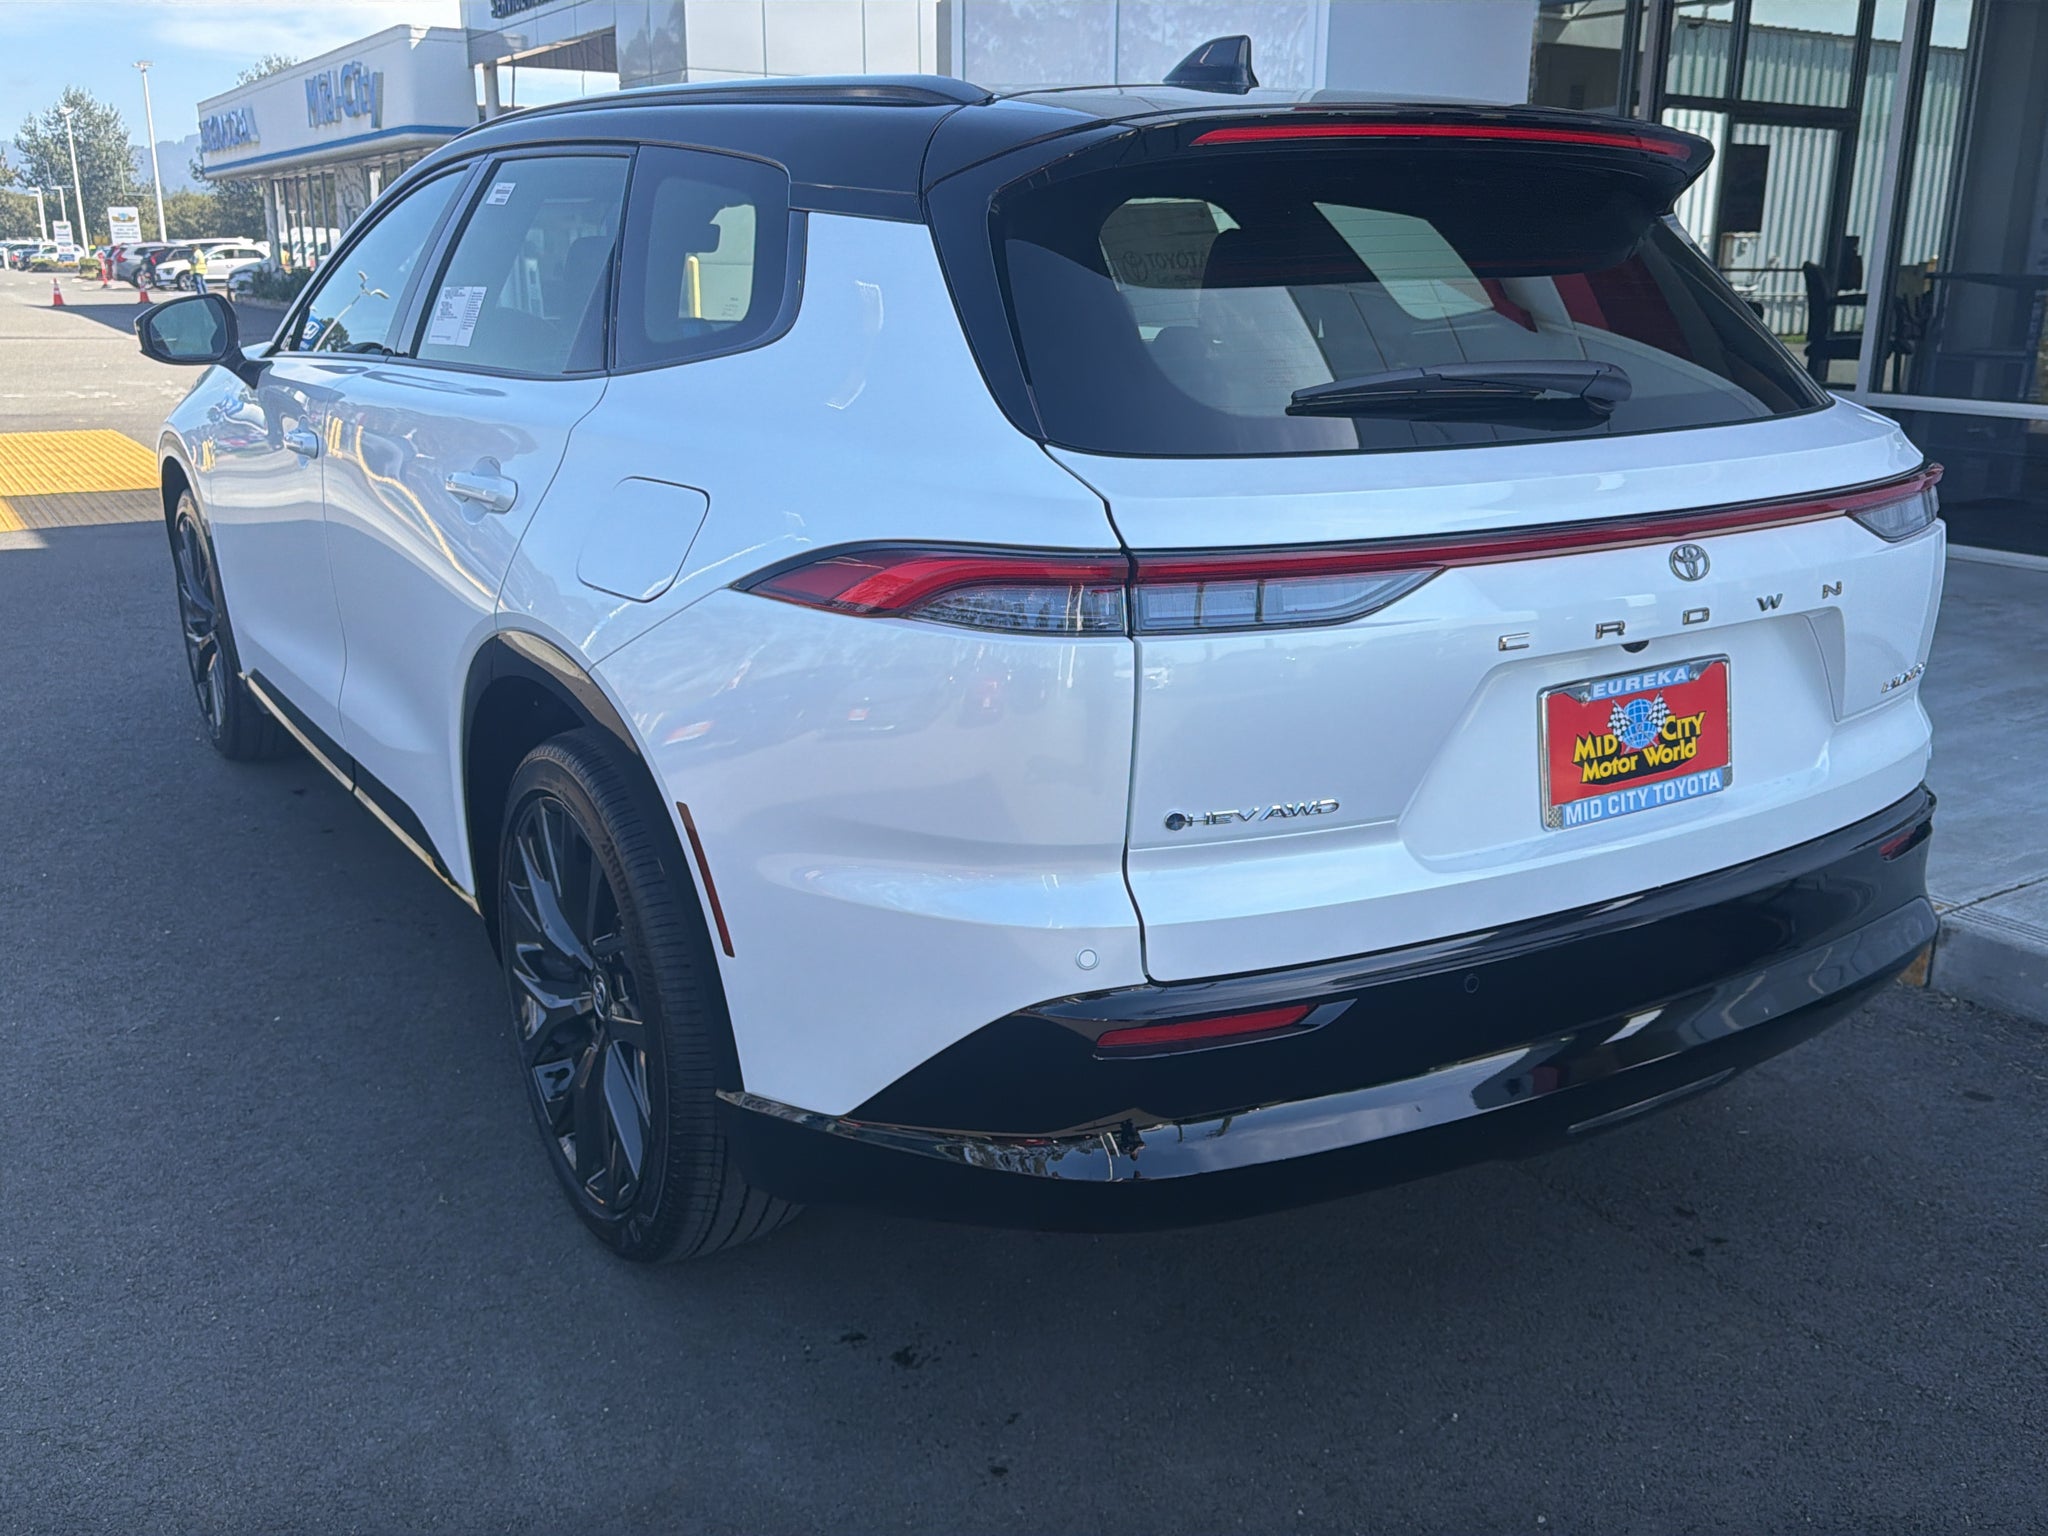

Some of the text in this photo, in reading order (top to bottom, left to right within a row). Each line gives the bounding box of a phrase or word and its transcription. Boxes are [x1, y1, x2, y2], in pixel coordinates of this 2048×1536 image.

[1498, 580, 1843, 651] CROWN
[1592, 667, 1689, 698] EUREKA
[1573, 712, 1706, 763] MID CITY
[1582, 736, 1697, 783] Motor World
[1259, 798, 1340, 821] AWD
[1565, 770, 1721, 827] MID CITY TOYOTA
